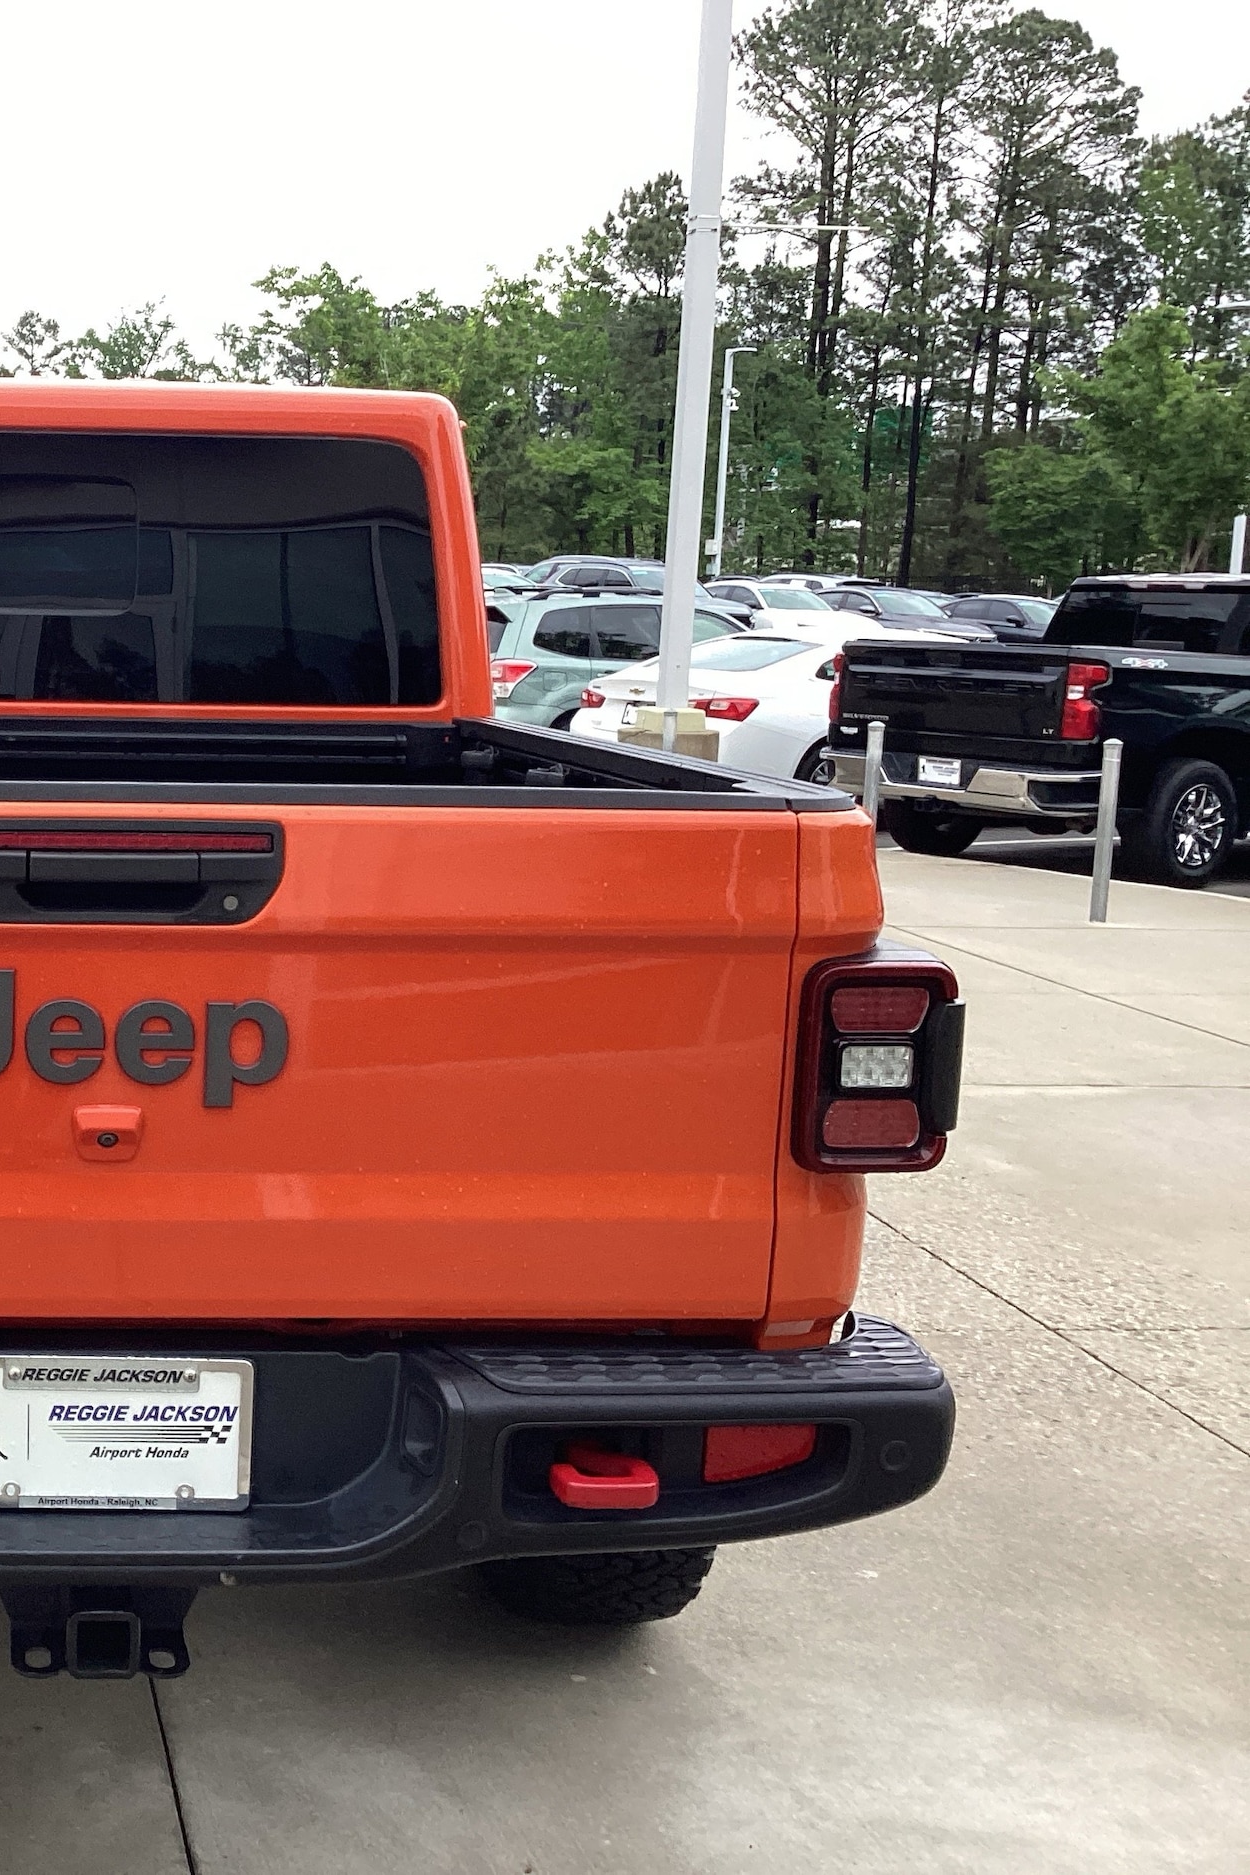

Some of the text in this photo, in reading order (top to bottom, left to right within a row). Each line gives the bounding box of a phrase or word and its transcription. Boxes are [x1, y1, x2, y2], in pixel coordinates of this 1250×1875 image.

[1042, 727, 1055, 735] LT
[21, 1368, 184, 1383] REGGIE JACKSON
[48, 1405, 239, 1422] REGGIE JACKSON
[88, 1446, 190, 1461] Airport Honda
[37, 1497, 68, 1507] Airport
[70, 1497, 99, 1506] Honda
[145, 1498, 159, 1506] NC
